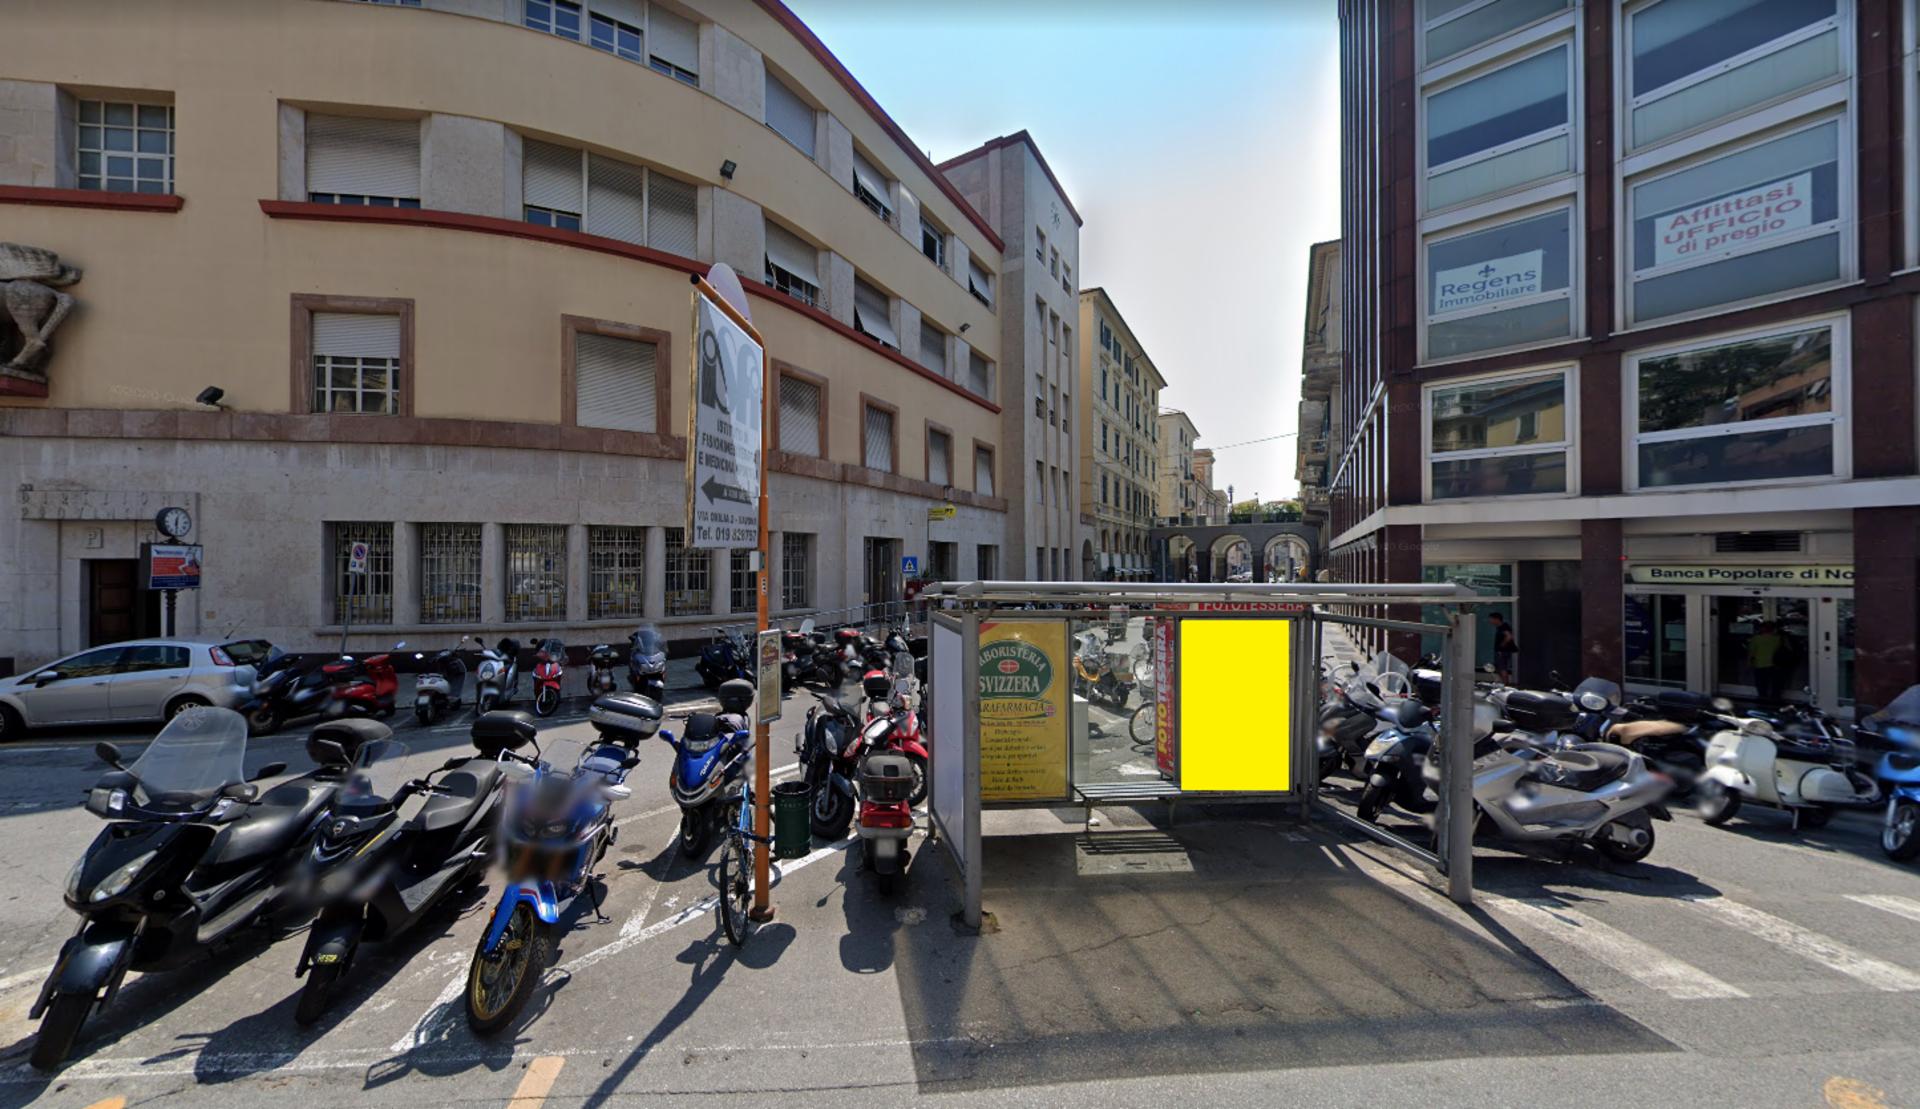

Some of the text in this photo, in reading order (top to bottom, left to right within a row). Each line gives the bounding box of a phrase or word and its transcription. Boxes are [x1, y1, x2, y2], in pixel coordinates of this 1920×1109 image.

[1669, 182, 1796, 230] Affittasi
[1663, 198, 1803, 245] UFFICIO
[1677, 218, 1785, 254] di pregio
[1441, 270, 1536, 296] Regens
[697, 526, 713, 540] Tel.
[715, 527, 730, 541] 019
[1651, 568, 1704, 579] Banca
[1709, 568, 1794, 580] Popolare
[1801, 568, 1818, 579] di
[979, 675, 1040, 693] SVIZZERA
[979, 702, 1044, 713] RAFARMACIA
